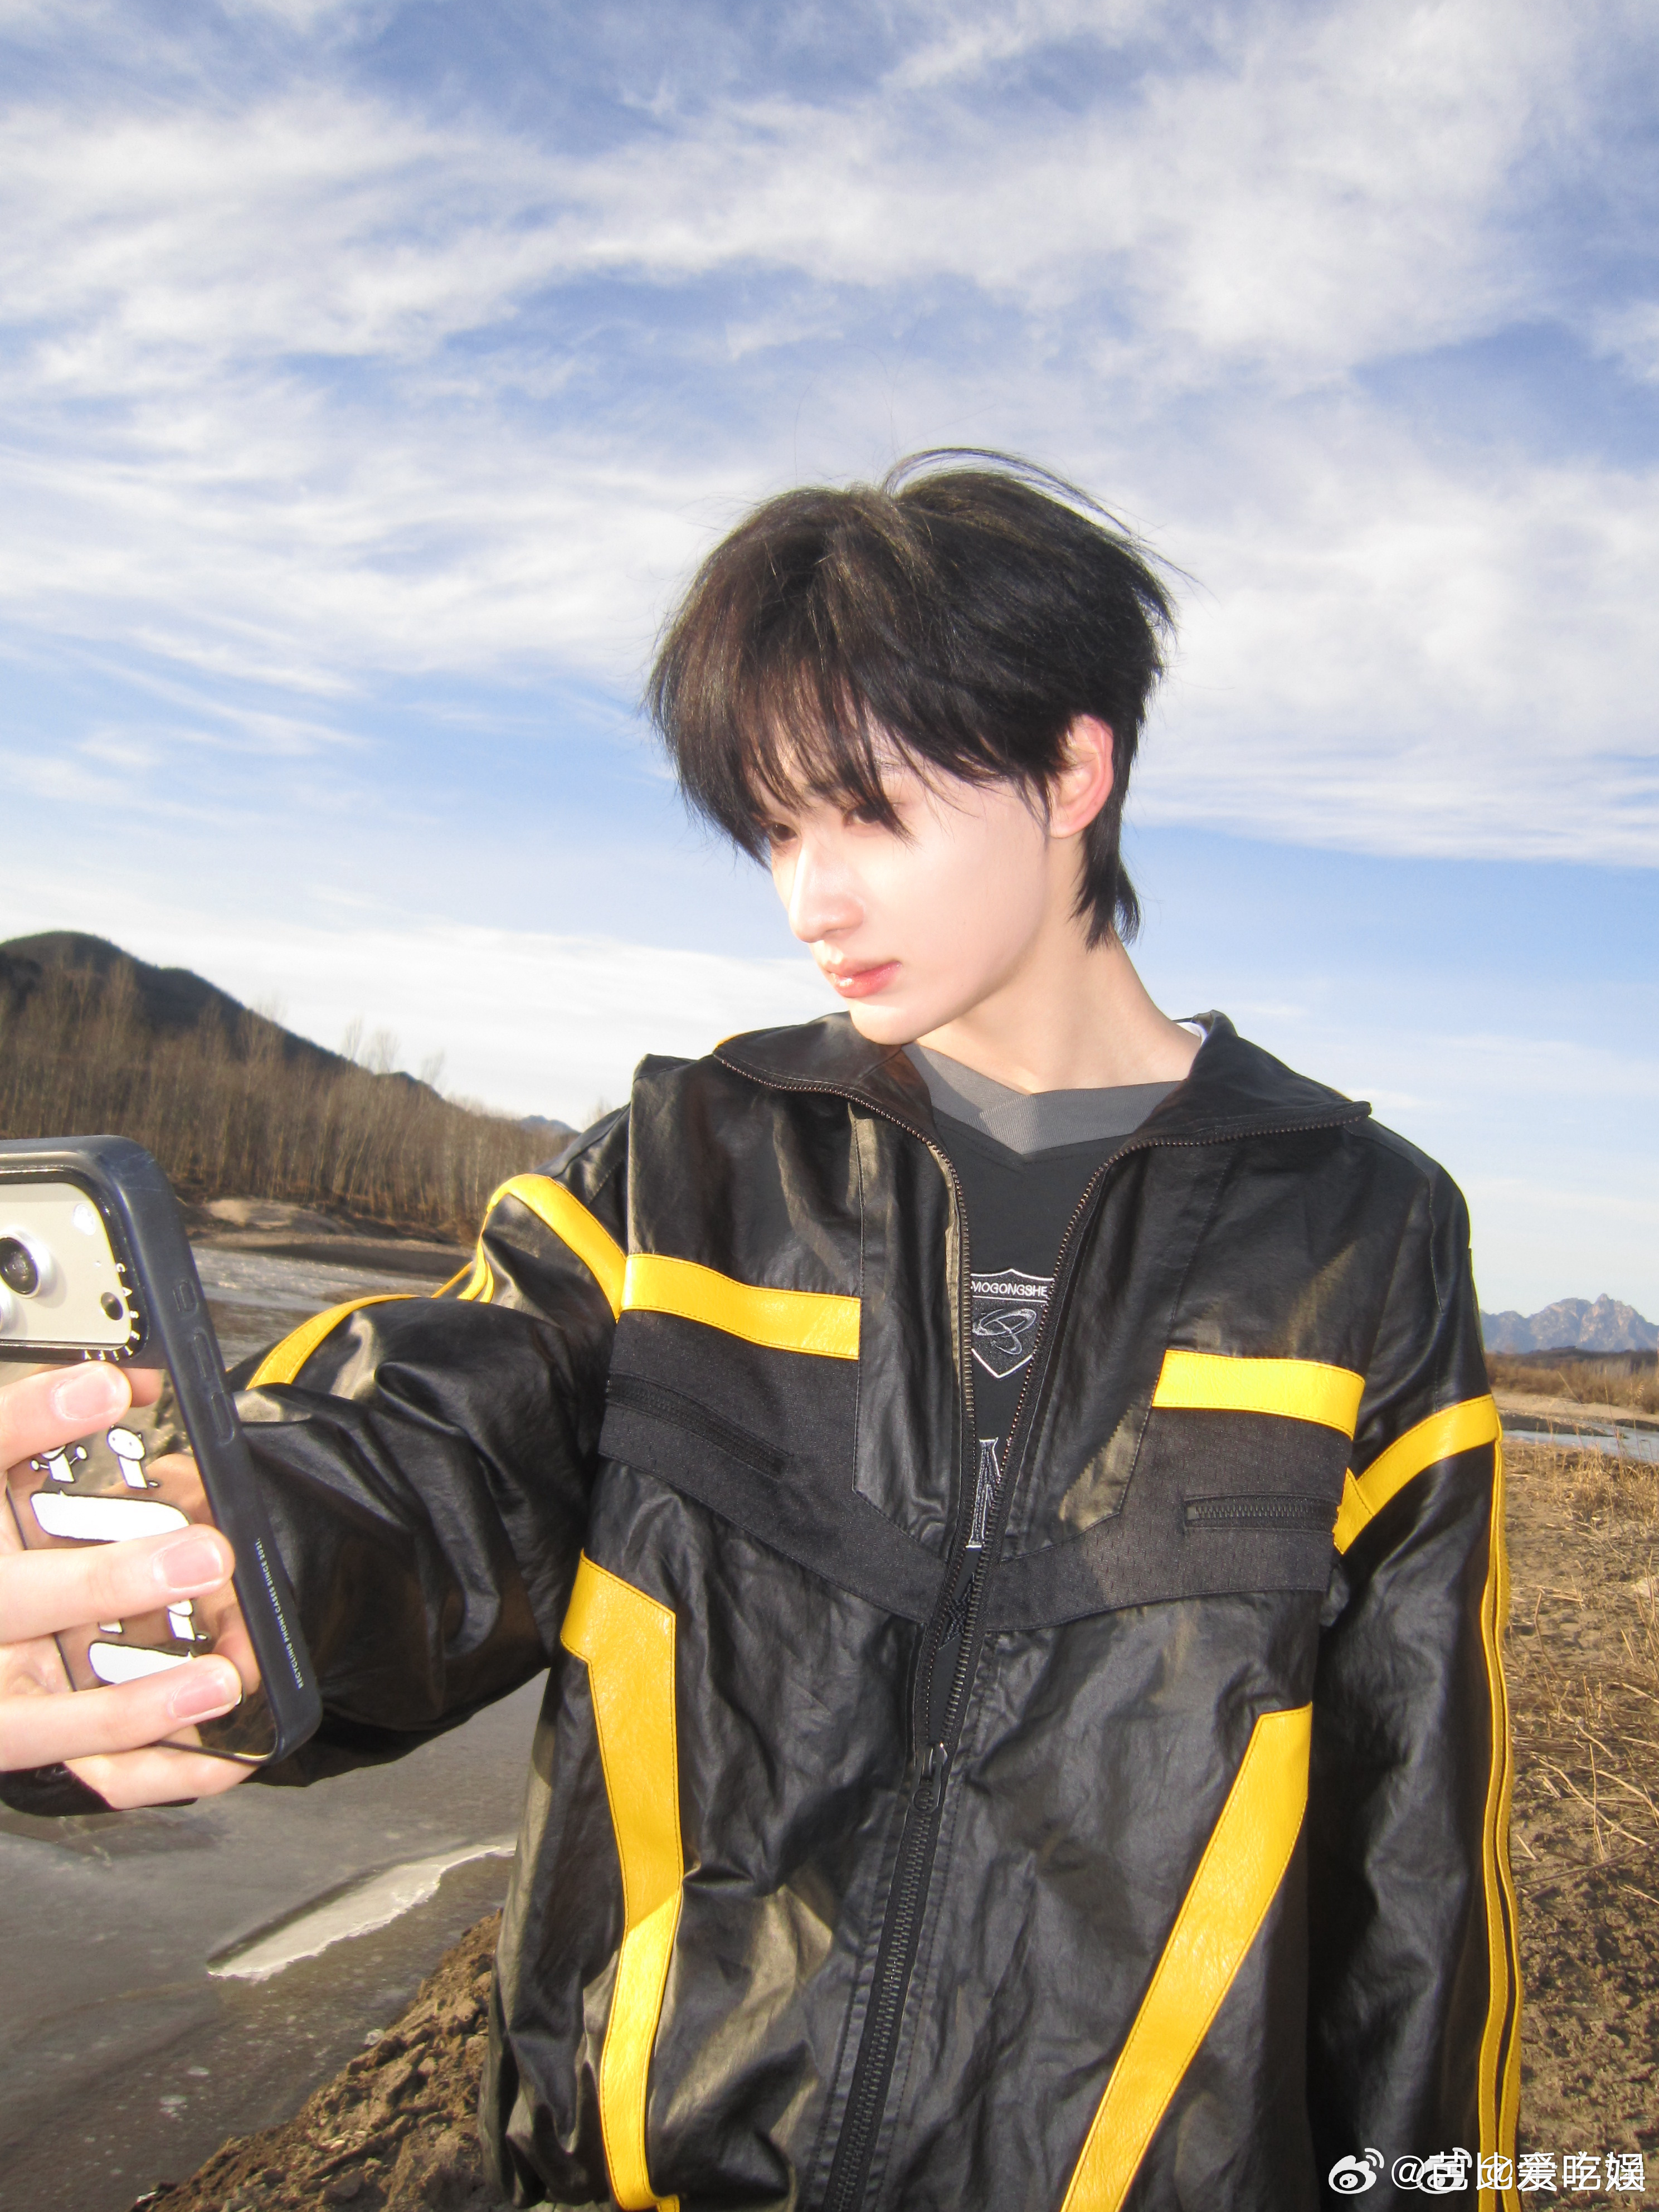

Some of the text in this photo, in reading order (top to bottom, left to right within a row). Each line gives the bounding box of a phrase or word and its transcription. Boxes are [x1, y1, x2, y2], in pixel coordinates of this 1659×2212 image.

[261, 1560, 273, 1587] SINCE
[269, 1586, 281, 1614] CASES
[277, 1613, 290, 1643] PHONE
[286, 1642, 304, 1689] RECYCLING
